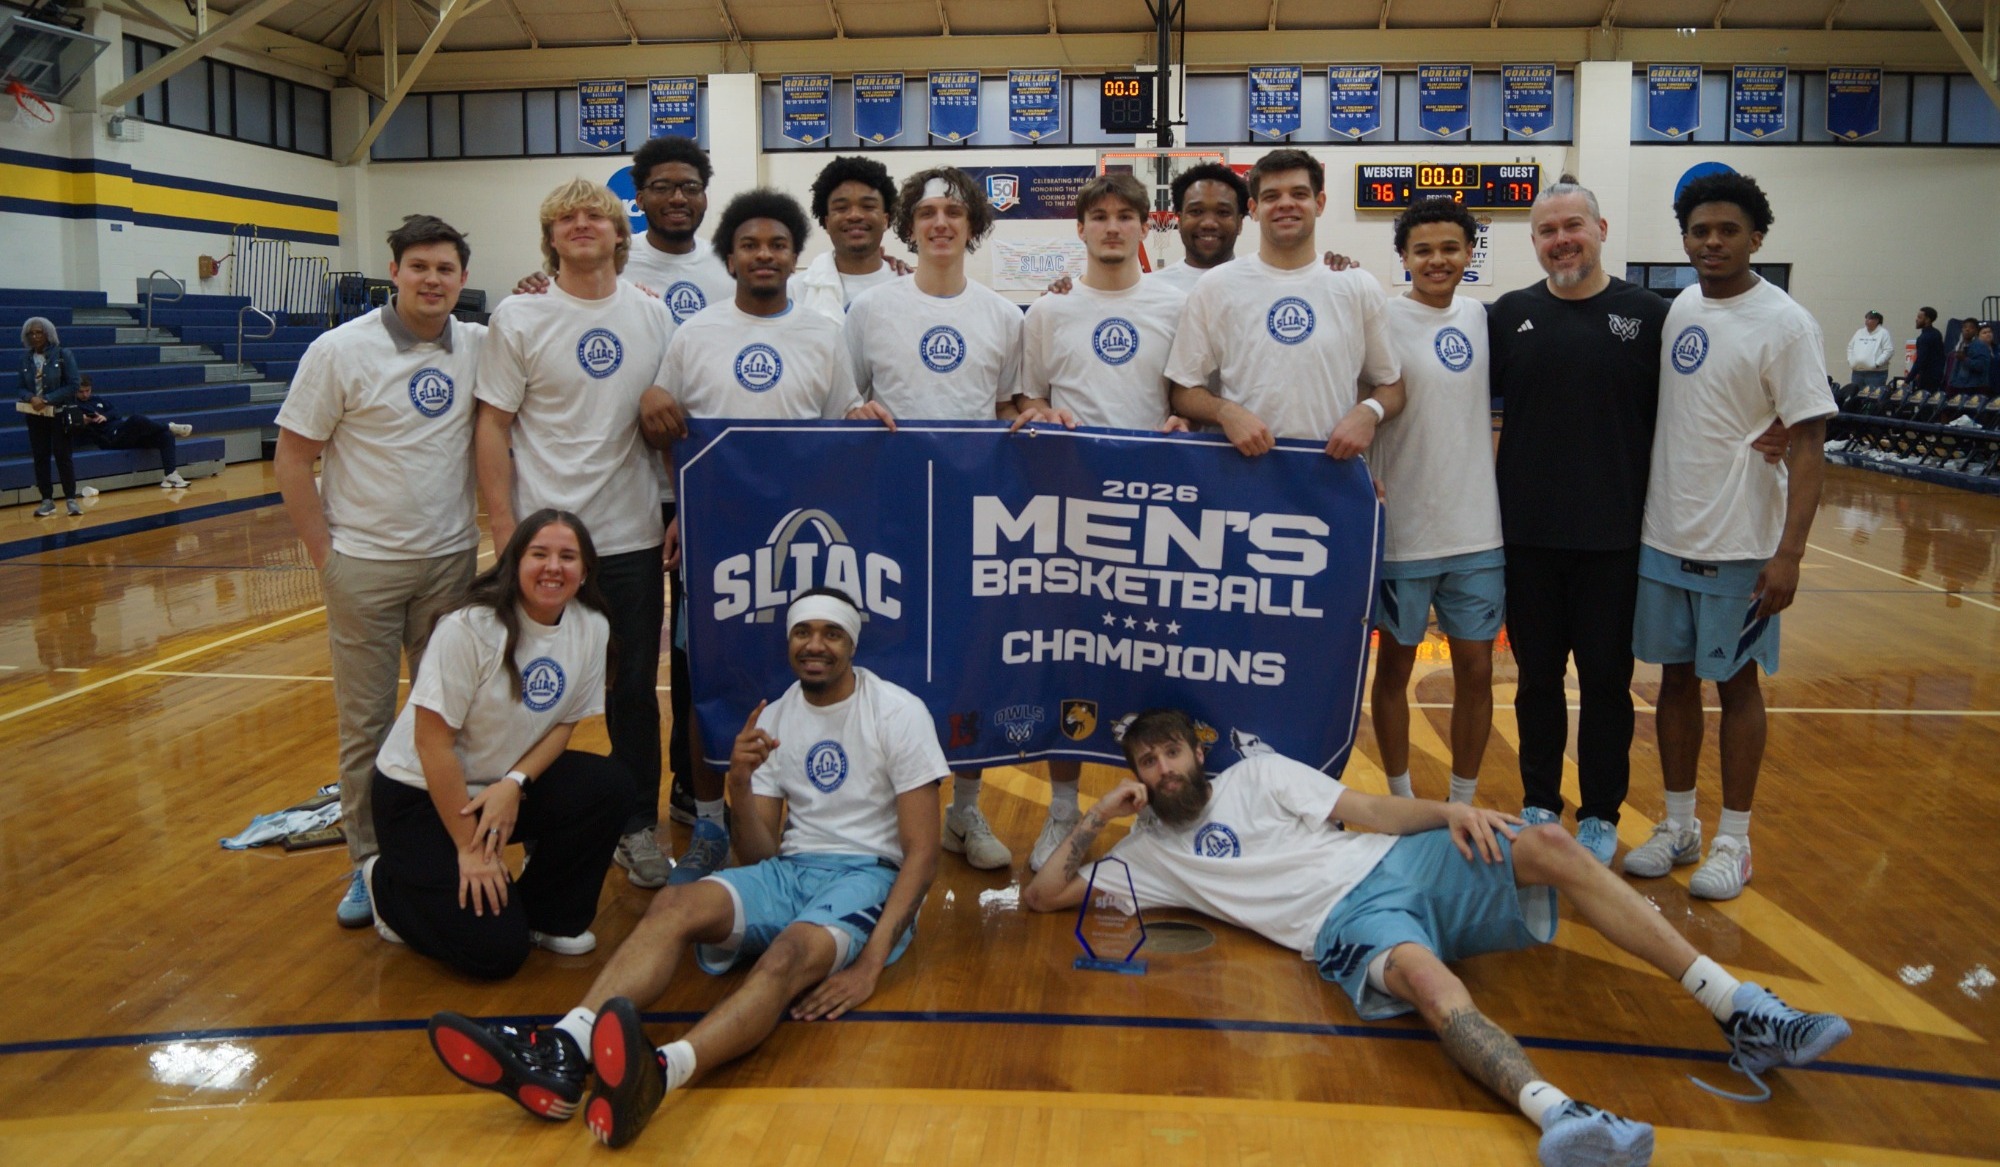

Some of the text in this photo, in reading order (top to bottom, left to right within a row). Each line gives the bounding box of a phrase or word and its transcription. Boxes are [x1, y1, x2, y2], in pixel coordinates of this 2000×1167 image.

[1104, 81, 1139, 96] 00.0
[1364, 166, 1413, 178] WEBSTER
[1422, 167, 1463, 185] 00.0
[1500, 166, 1534, 178] GUEST
[1372, 184, 1394, 202] 76
[1455, 190, 1463, 203] 2
[1510, 184, 1532, 200] 77
[1020, 255, 1064, 272] SLIAC
[674, 298, 699, 311] SLIAC
[1276, 316, 1306, 329] SLIAC
[1102, 336, 1130, 349] SLIAC
[588, 348, 614, 362] SLIAC
[929, 345, 957, 357] SLIAC
[1444, 344, 1466, 357] SLIAC
[1678, 344, 1700, 360] SLIAC
[744, 362, 773, 374] SLIAC
[420, 388, 447, 401] SLIAC
[1102, 480, 1198, 502] 2026
[973, 495, 1330, 576] MEN'S
[714, 543, 901, 620] SLIAC
[972, 558, 1324, 618] BASKETBALL
[1002, 629, 1286, 686] CHAMPIONS
[529, 678, 556, 692] SLIAC
[994, 704, 1044, 726] OWLS
